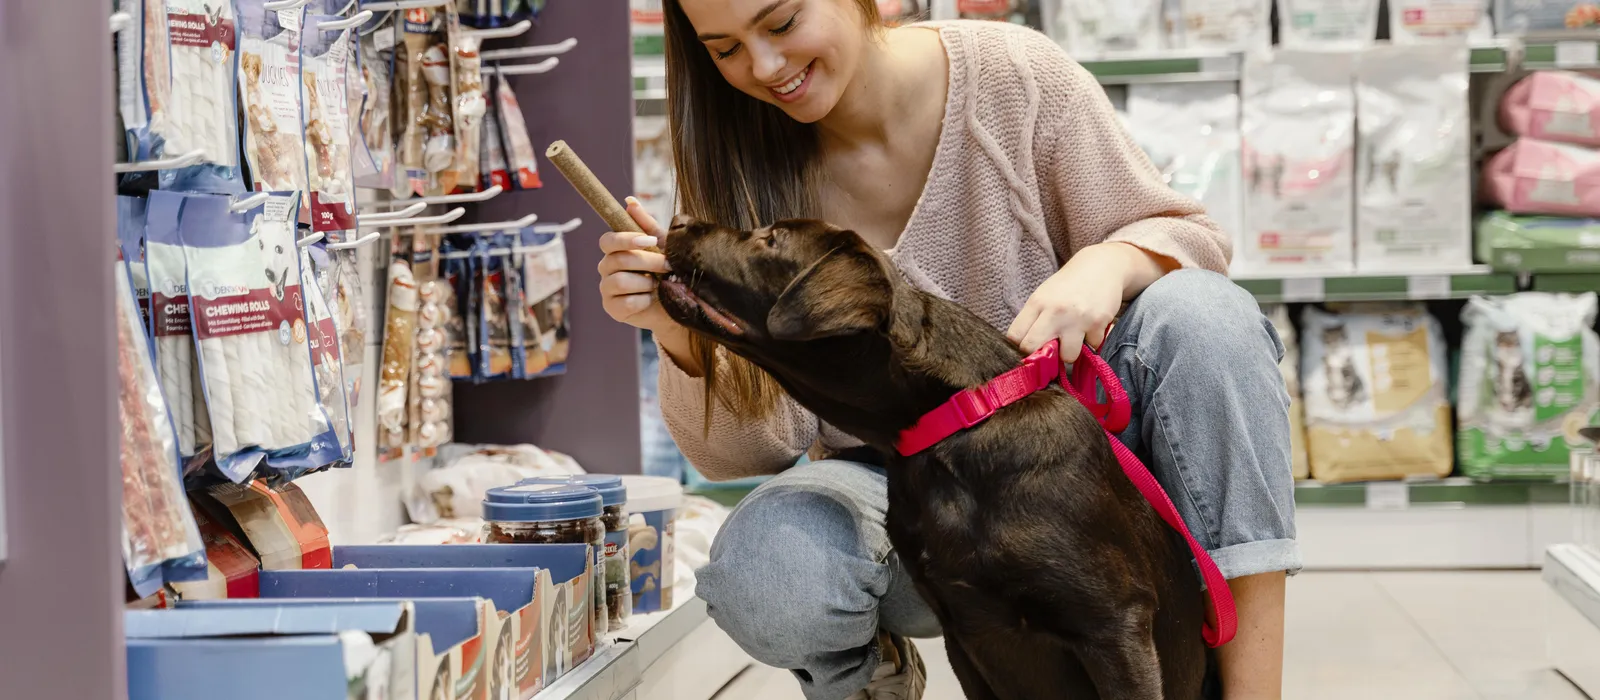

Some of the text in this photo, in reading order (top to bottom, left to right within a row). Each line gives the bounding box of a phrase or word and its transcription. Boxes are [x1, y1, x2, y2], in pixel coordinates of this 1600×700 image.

[170, 20, 206, 30] EWING ROLLS
[164, 304, 188, 314] CHE
[206, 300, 270, 317] CHEWING ROLLS
